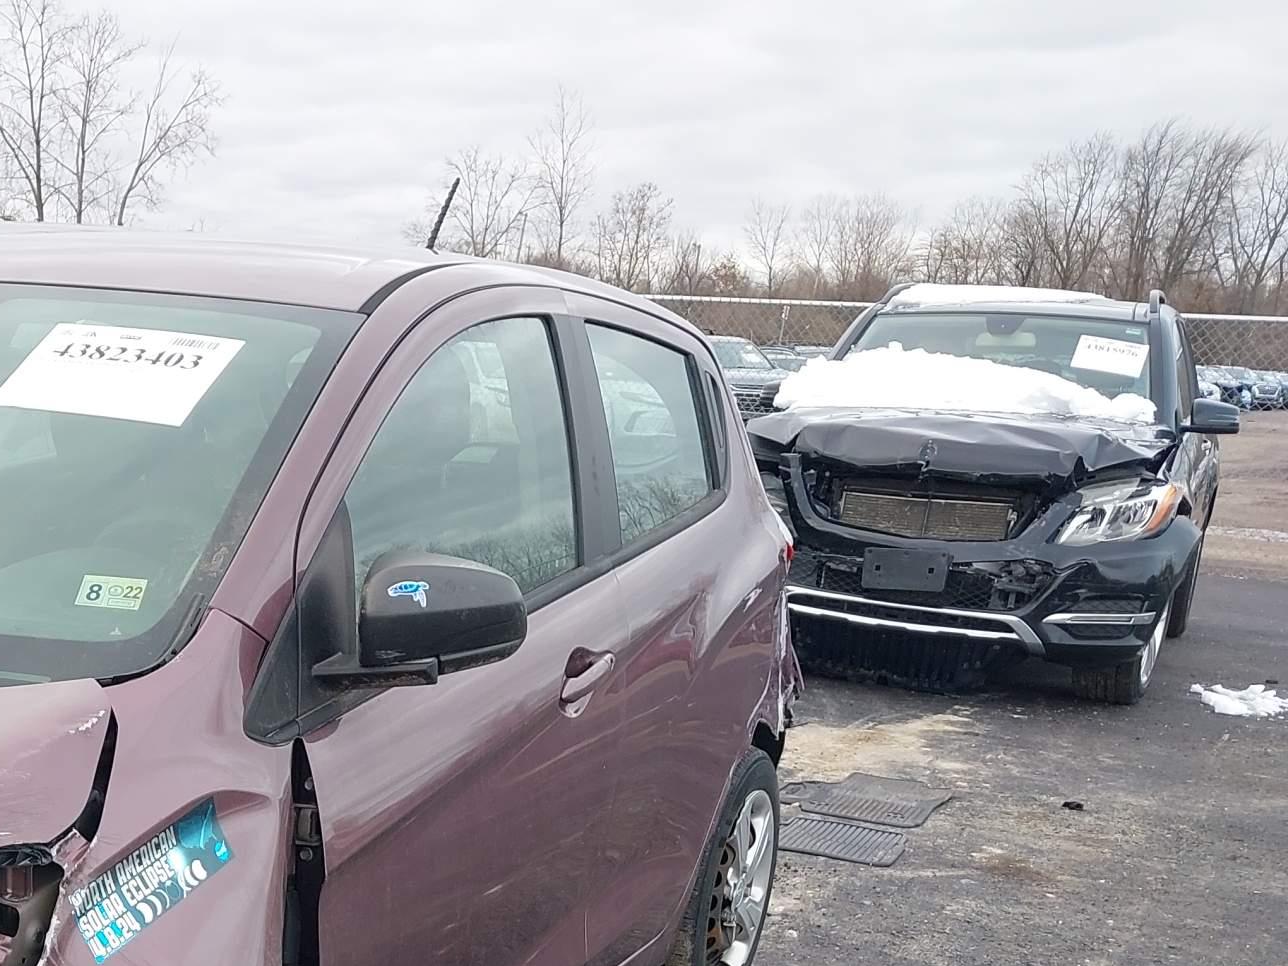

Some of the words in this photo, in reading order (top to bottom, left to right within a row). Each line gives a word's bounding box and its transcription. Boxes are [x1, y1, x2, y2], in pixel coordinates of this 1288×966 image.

[53, 342, 203, 370] 43823403
[86, 584, 102, 601] 8
[123, 586, 143, 599] 22
[73, 871, 116, 916] NORTH
[115, 826, 177, 885] AMERICAN
[78, 893, 127, 938] SOLAR
[121, 853, 175, 906] ECLIPSE
